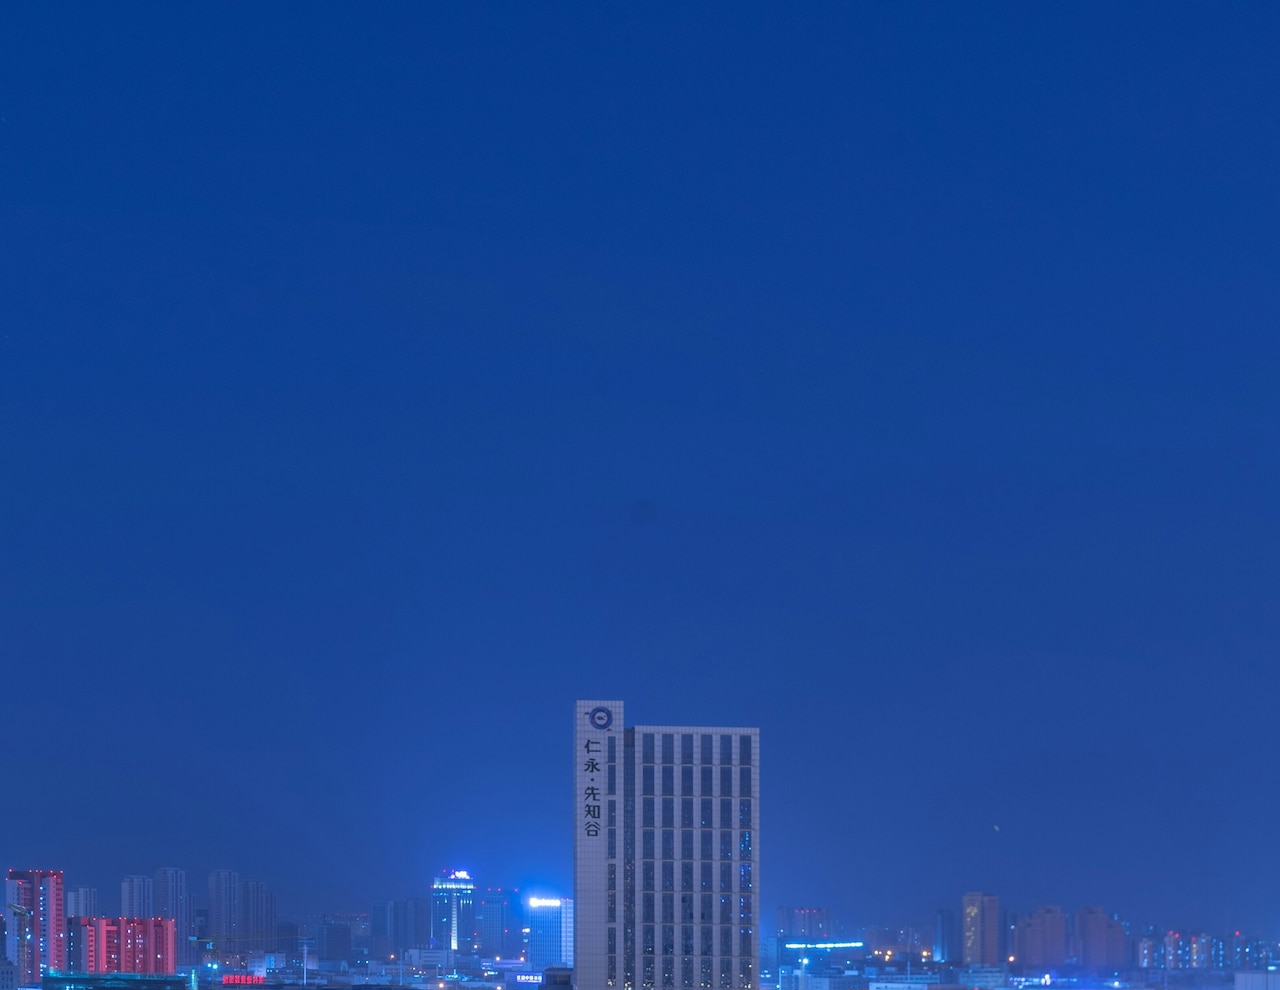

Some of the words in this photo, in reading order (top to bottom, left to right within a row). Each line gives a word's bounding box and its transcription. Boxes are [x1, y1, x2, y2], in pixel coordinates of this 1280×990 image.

[584, 739, 601, 837] 仁永·先知谷
